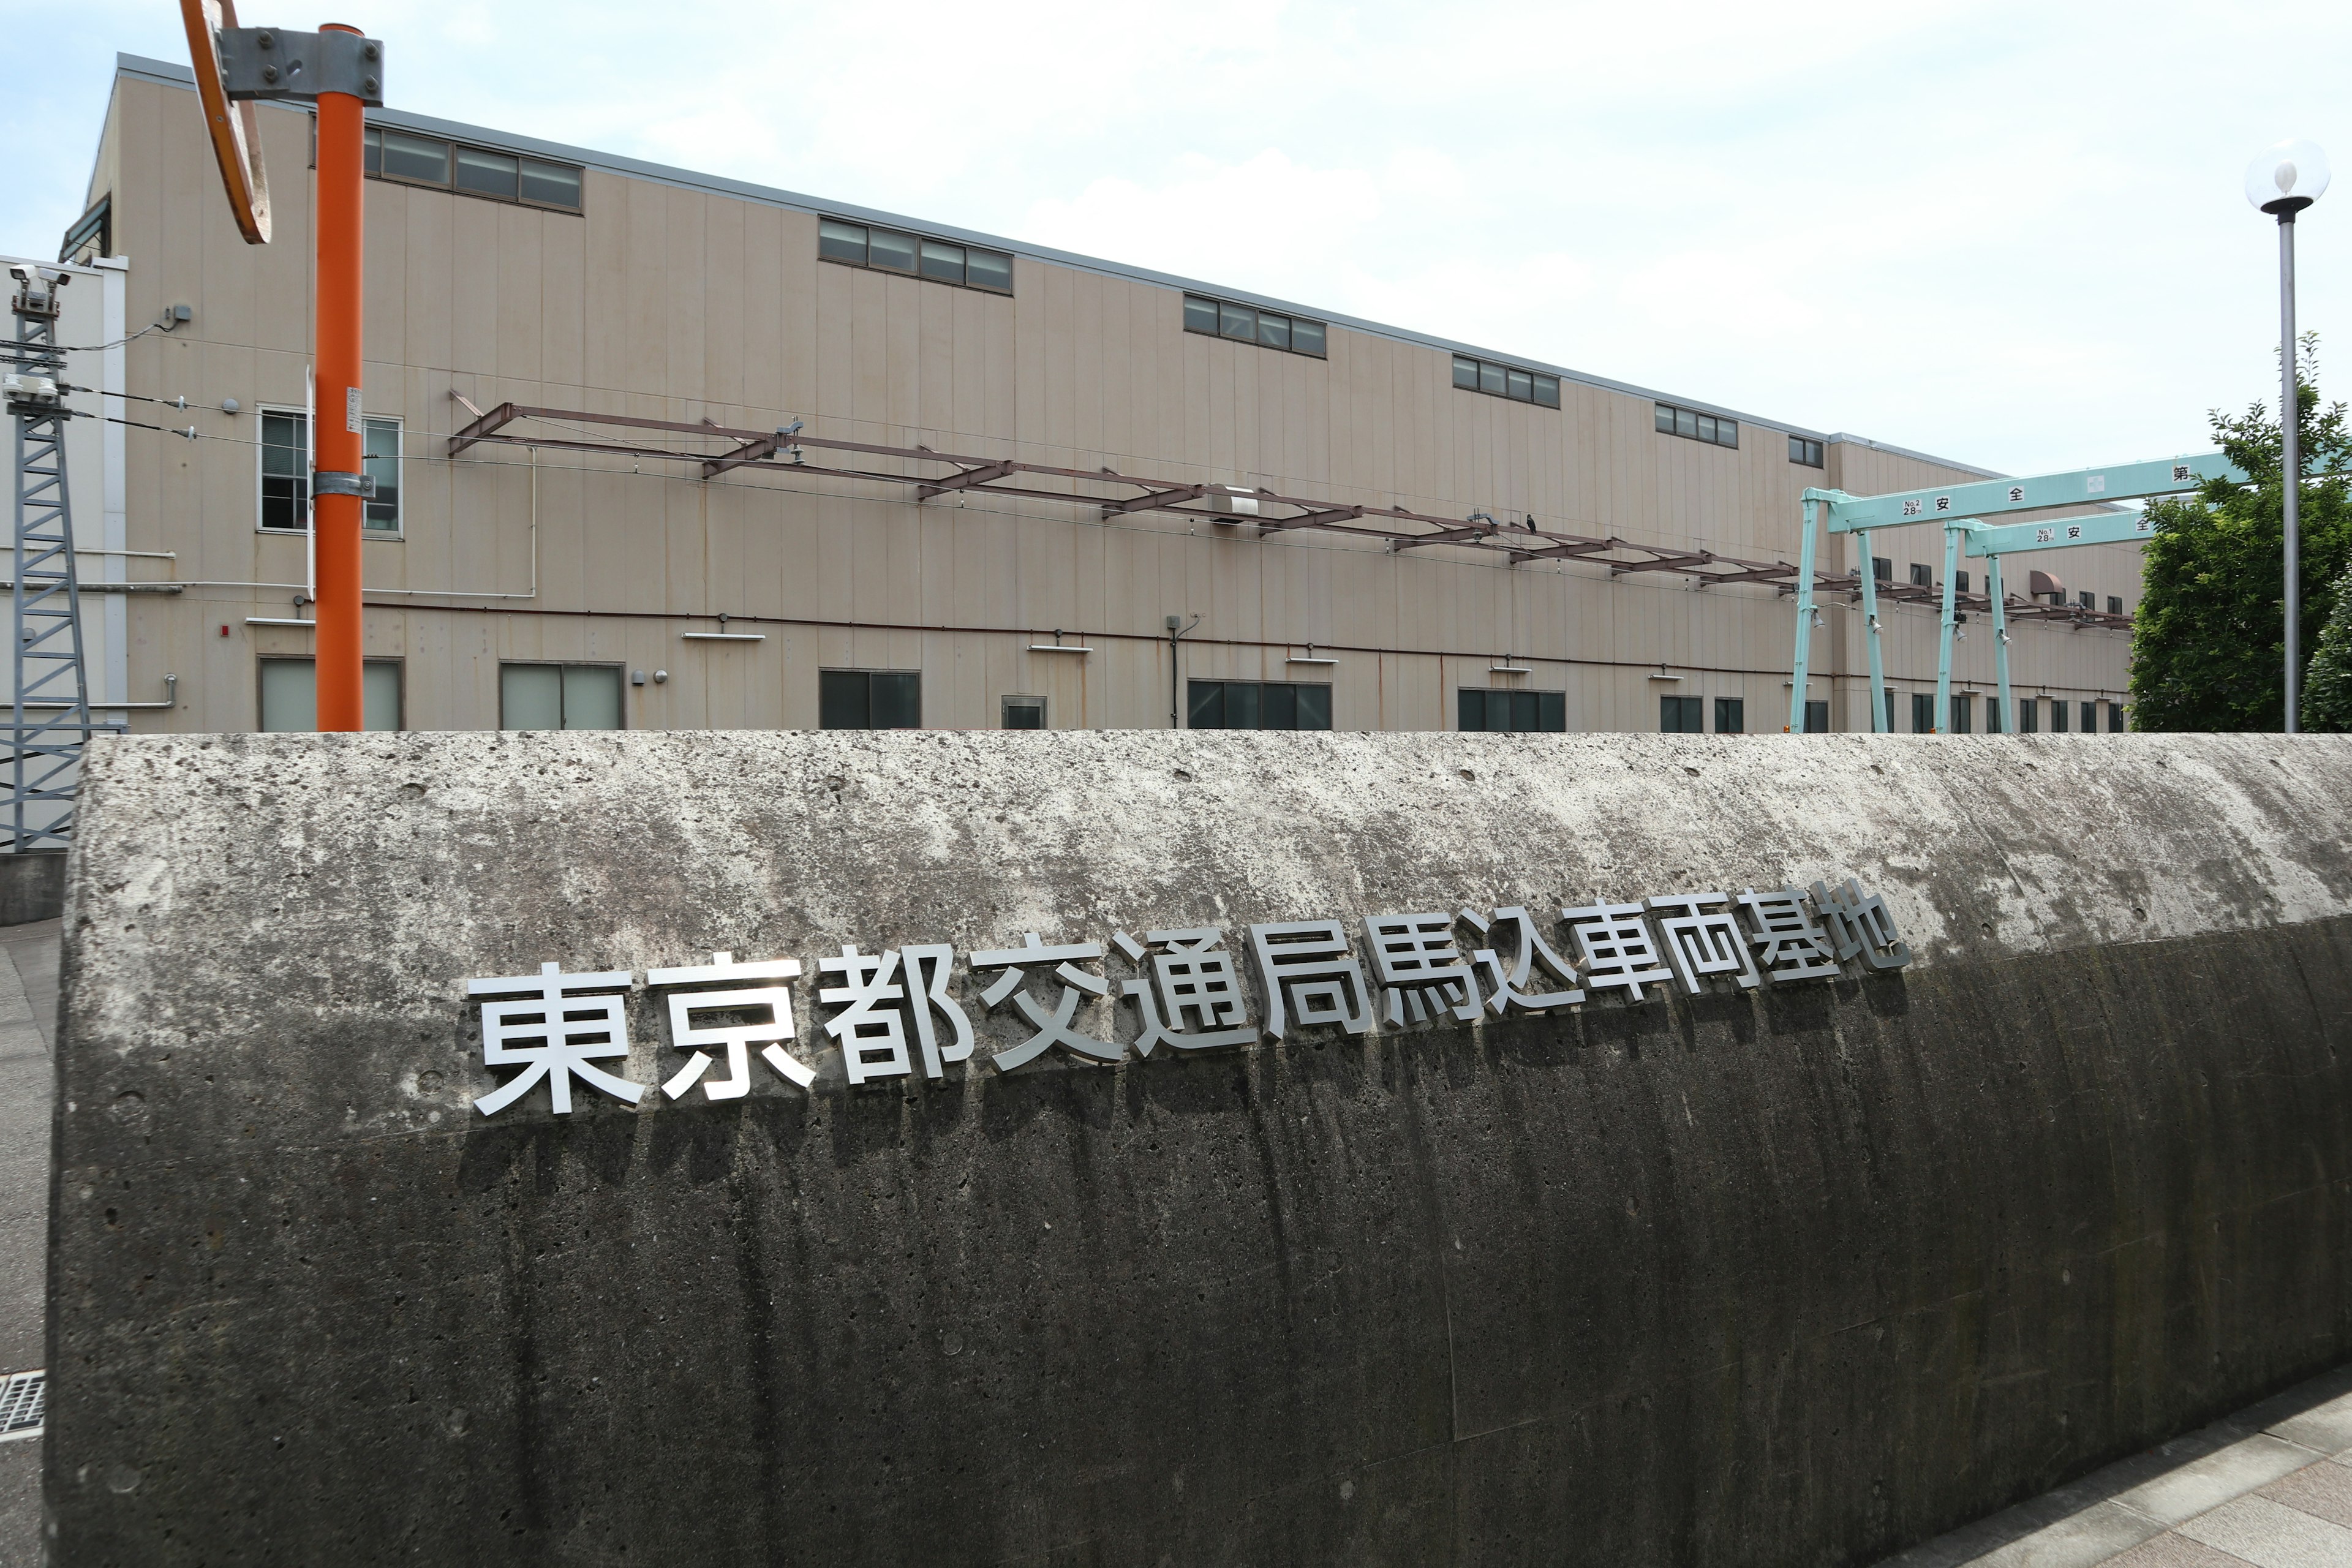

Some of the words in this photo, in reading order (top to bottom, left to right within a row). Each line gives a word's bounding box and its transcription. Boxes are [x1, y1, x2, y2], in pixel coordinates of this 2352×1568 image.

[467, 877, 1911, 1117] 東京都交通局馬込車両基地
